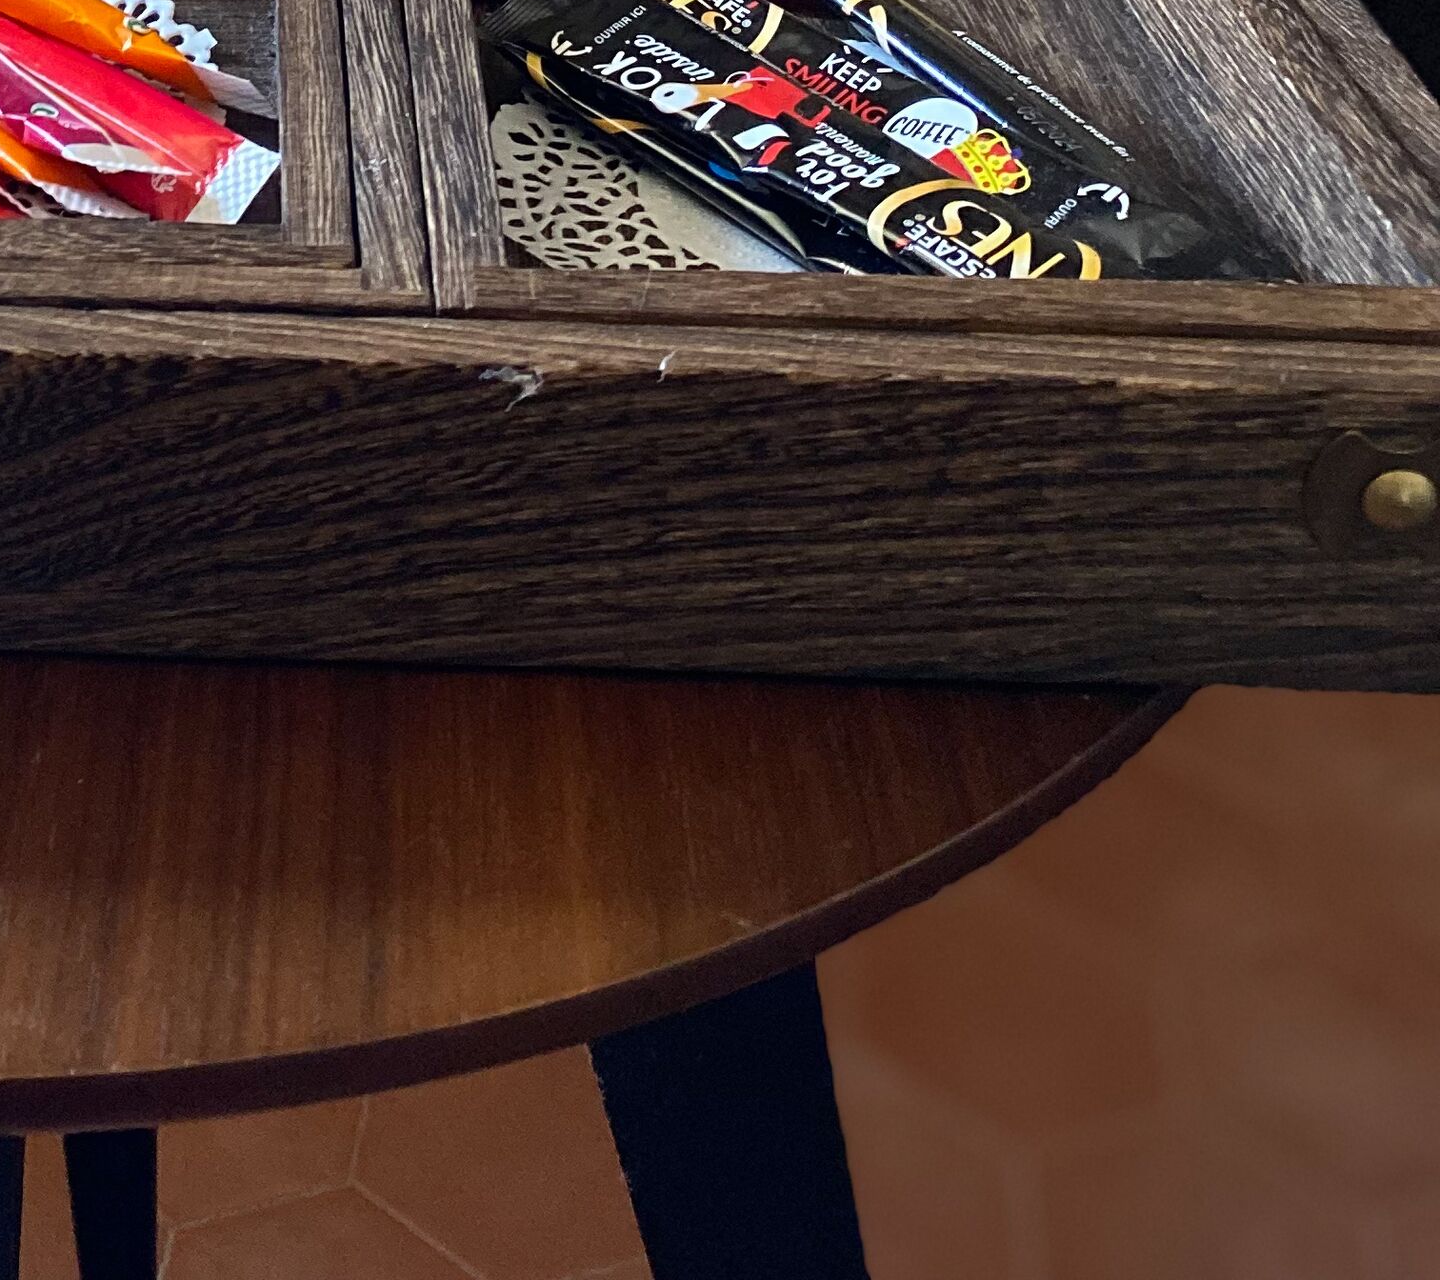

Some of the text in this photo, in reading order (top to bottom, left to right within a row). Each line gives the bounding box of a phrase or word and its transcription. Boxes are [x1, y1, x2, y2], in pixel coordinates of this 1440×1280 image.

[594, 5, 647, 45] OUVRIR ICI
[784, 57, 889, 125] SMILING
[818, 52, 882, 93] KEEP
[1017, 74, 1033, 86] de
[814, 122, 886, 166] moments
[888, 116, 965, 148] COFFEE
[795, 140, 901, 189] good
